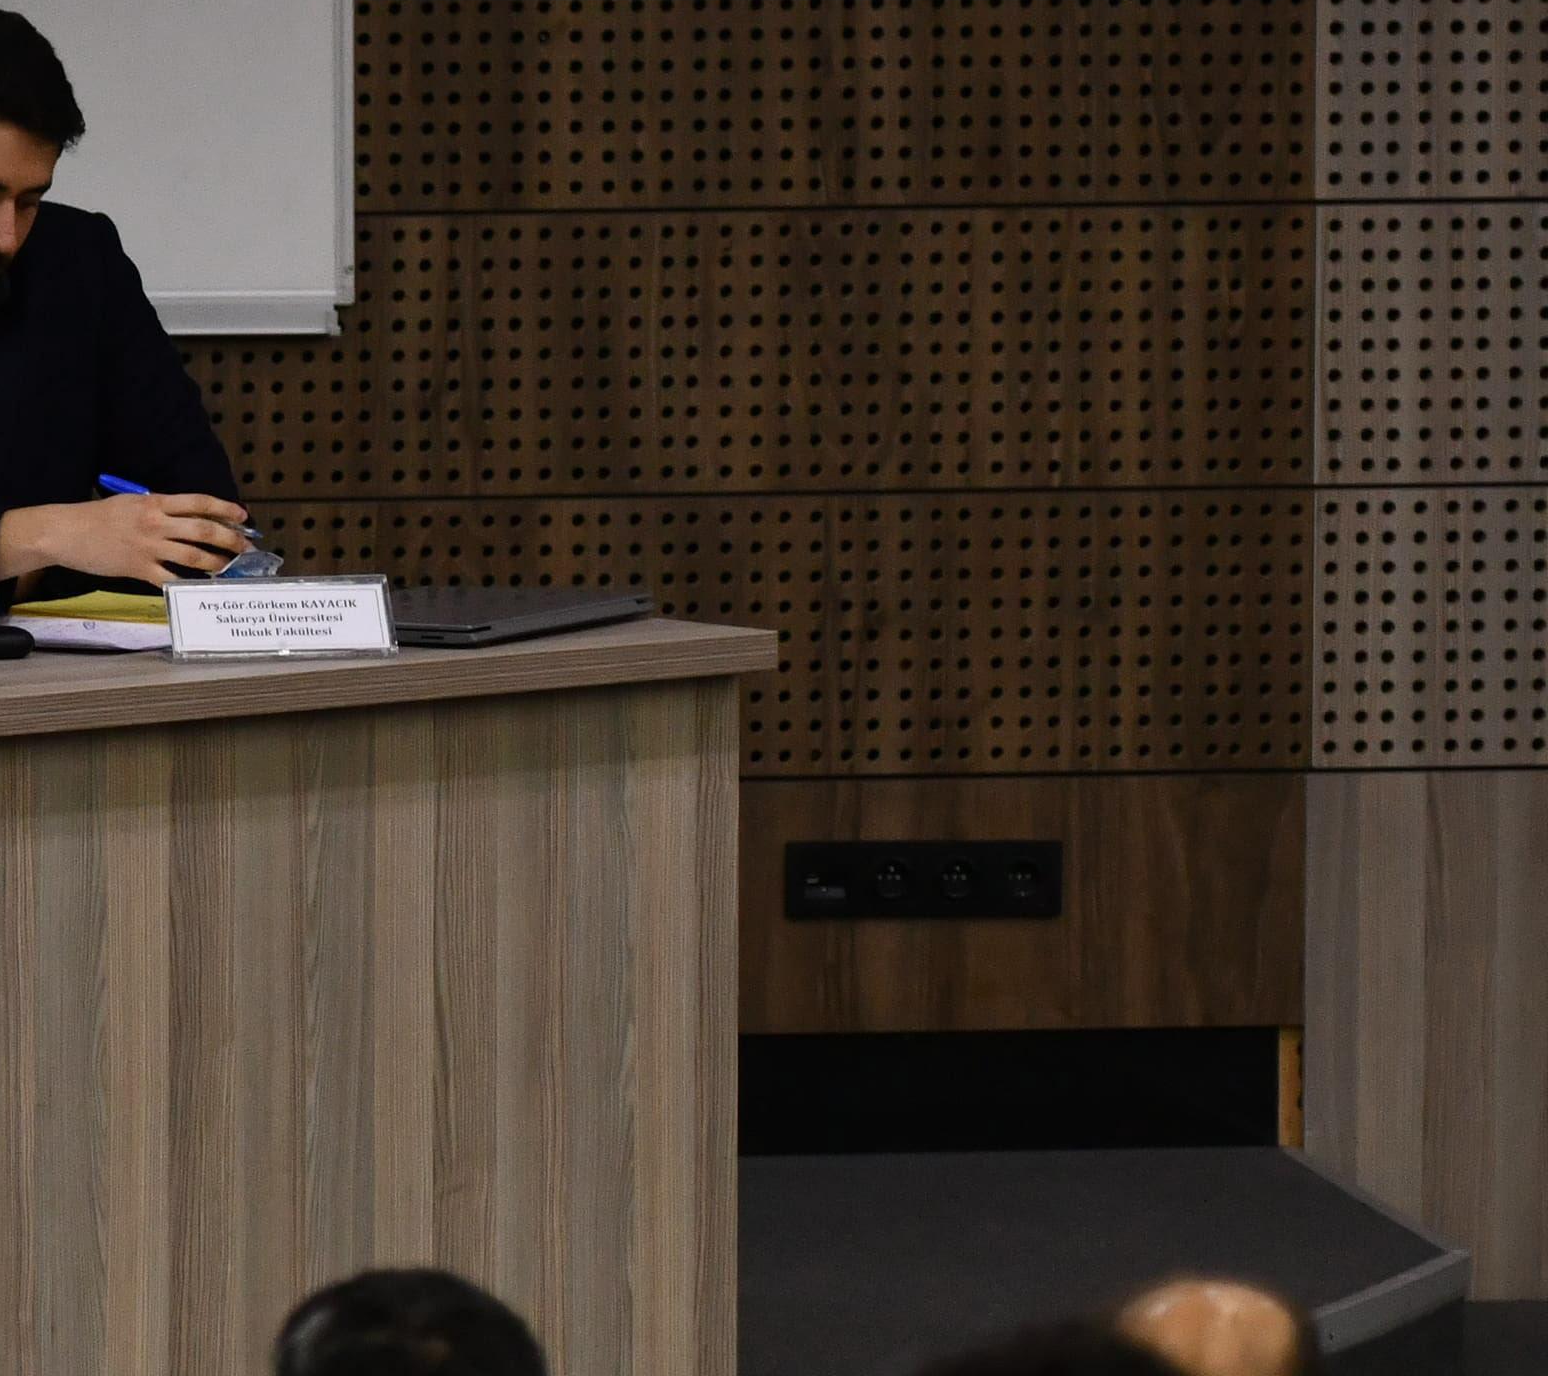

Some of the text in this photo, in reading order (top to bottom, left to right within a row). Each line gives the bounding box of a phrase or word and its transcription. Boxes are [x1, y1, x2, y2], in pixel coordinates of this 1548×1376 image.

[301, 598, 358, 610] KAYACIK
[215, 612, 344, 626] Sakarya Üniversitesi
[230, 627, 333, 638] Hukuk Fakültesi
